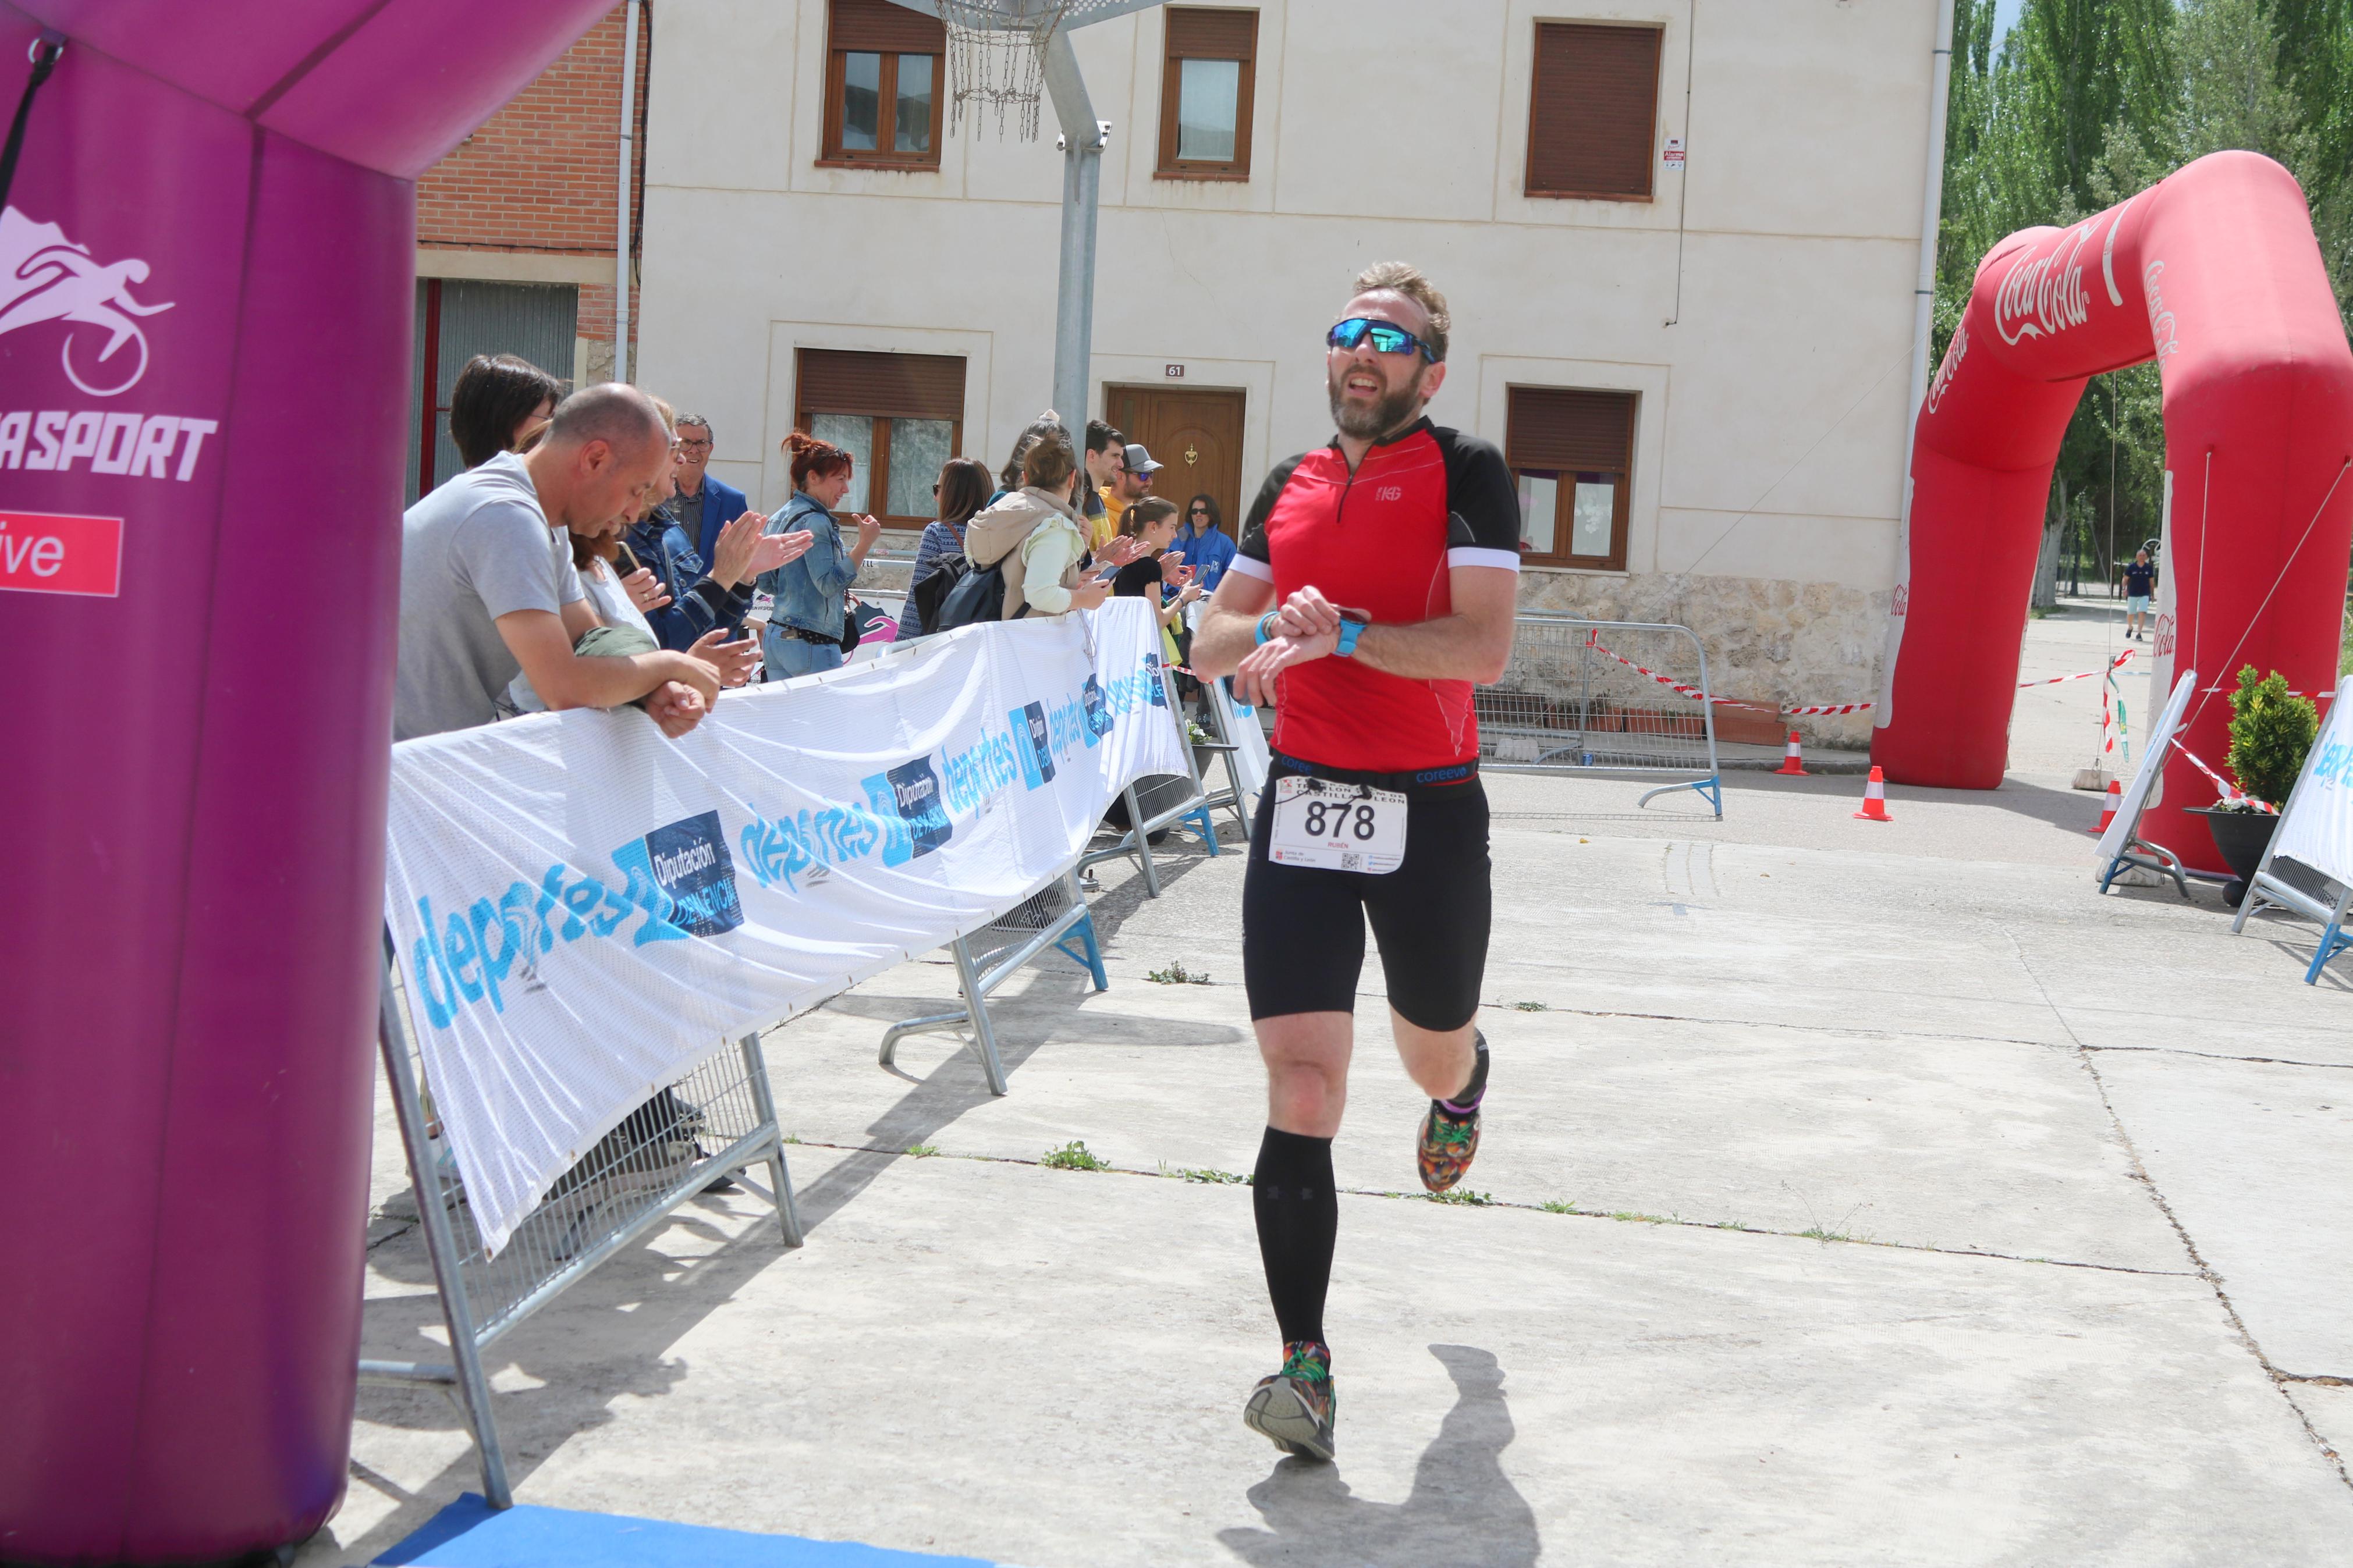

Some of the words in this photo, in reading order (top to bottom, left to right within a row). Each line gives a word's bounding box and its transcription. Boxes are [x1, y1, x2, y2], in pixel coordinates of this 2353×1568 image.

[1169, 366, 1180, 376] 61
[0, 410, 218, 482] ASPORT
[1305, 801, 1375, 841] 878
[654, 837, 716, 890] Diputación
